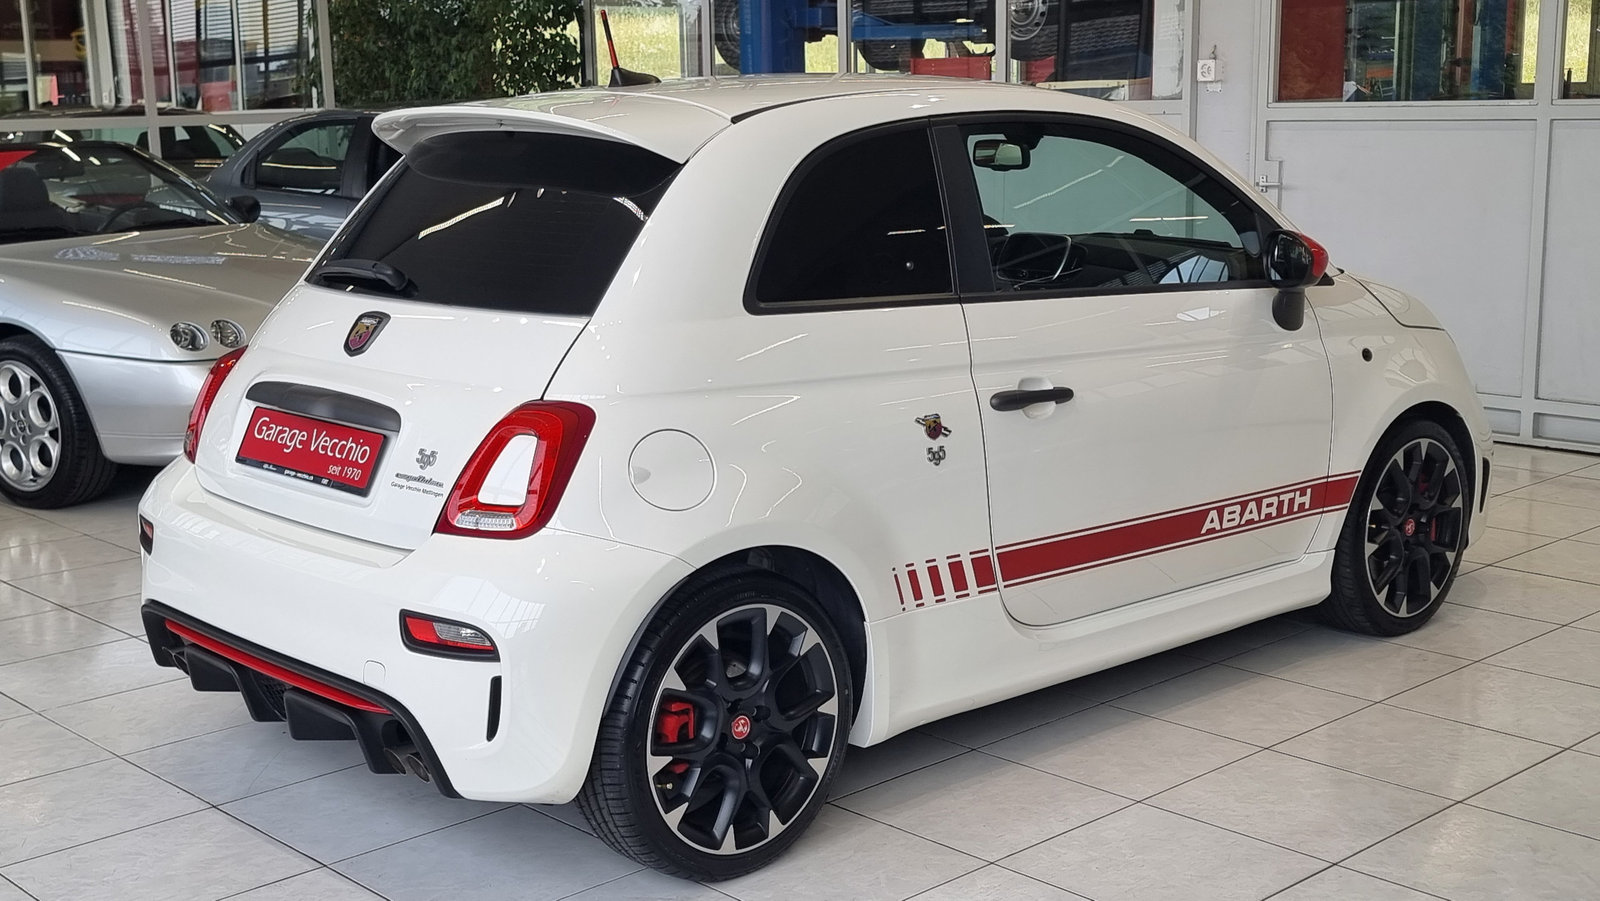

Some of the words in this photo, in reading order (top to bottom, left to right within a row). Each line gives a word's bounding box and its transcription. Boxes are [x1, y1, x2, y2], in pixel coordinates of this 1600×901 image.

[254, 417, 308, 453] Garage
[310, 428, 370, 464] Vecchio
[327, 464, 341, 477] seit
[342, 466, 362, 481] 1970
[1200, 488, 1312, 534] ABARTH
